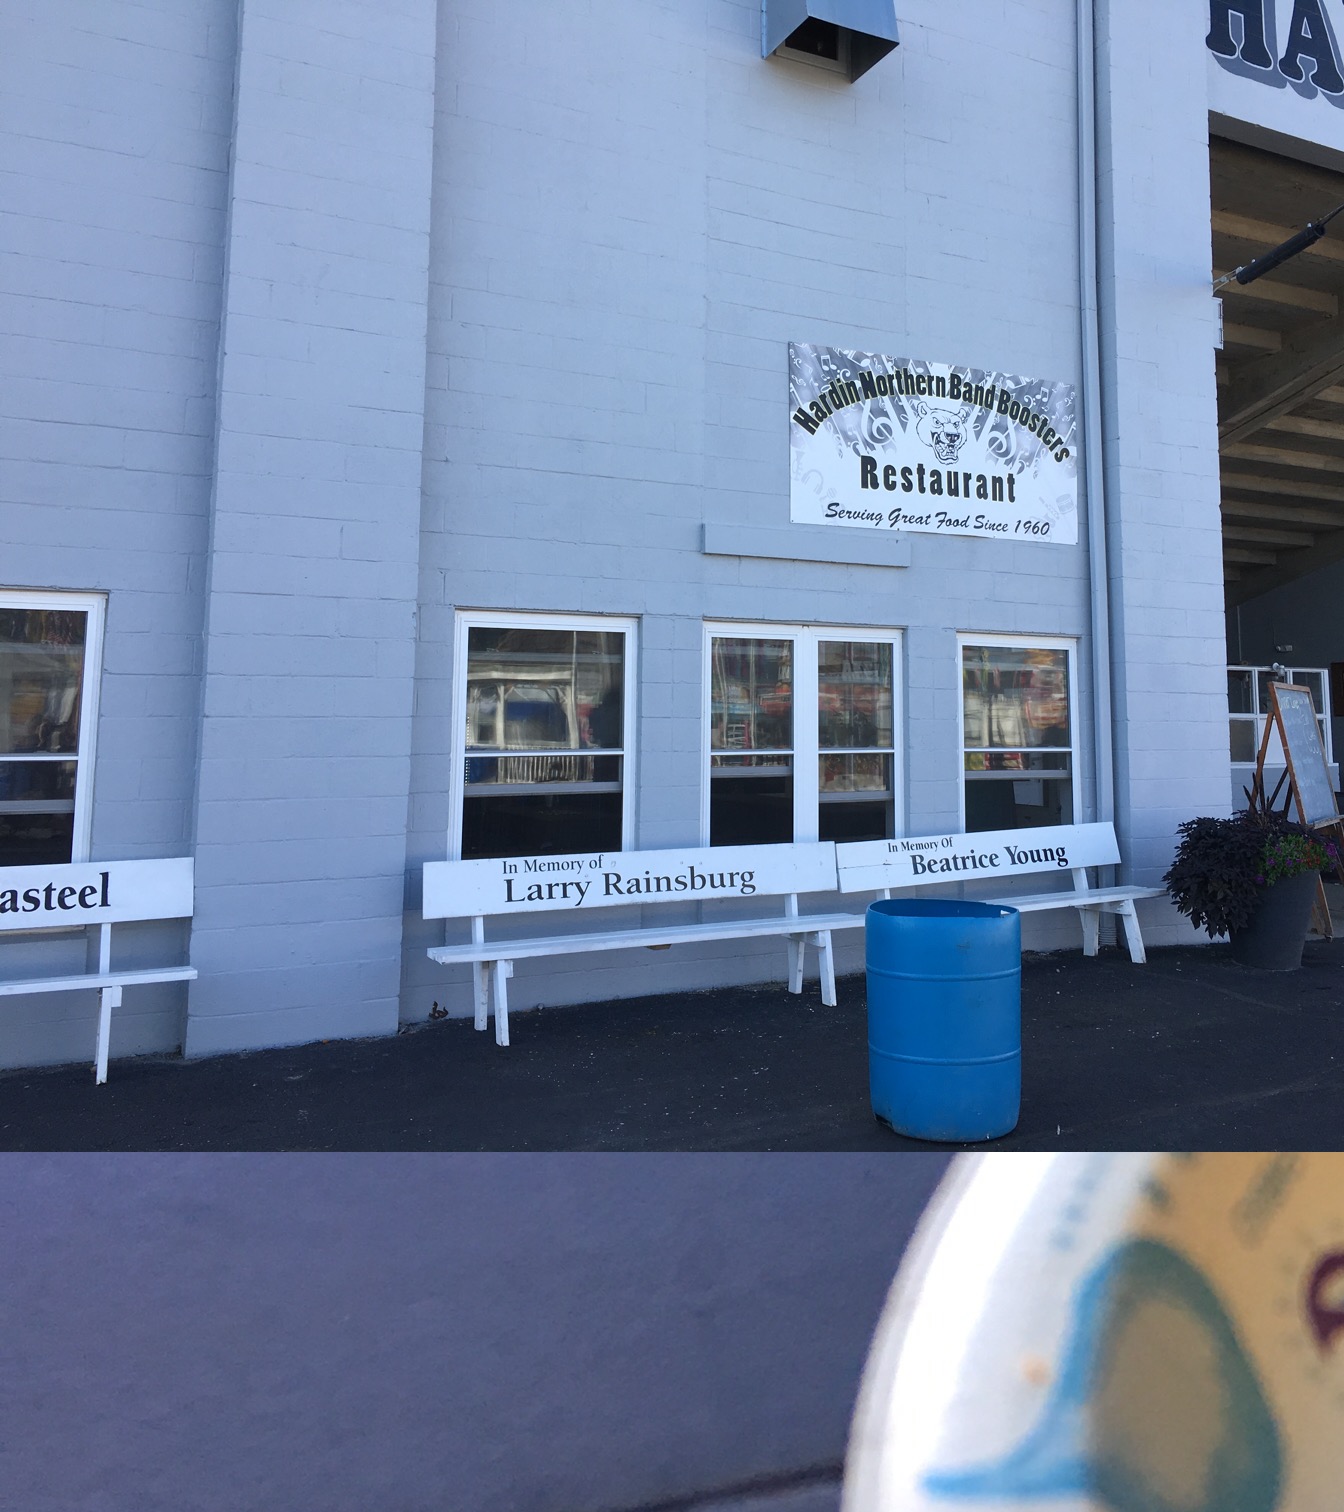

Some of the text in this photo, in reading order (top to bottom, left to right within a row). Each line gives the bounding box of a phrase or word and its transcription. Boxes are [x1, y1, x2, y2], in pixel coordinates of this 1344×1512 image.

[792, 367, 1070, 463] Hardin Northern Band Boosters
[860, 455, 1016, 503] Restaurant
[825, 502, 1050, 536] Serving Great Food Since 1960
[887, 837, 953, 852] In Memory Of
[910, 845, 1069, 875] Beatrice Young
[502, 854, 604, 875] In Memory of
[504, 865, 757, 906] Larry Rainsburg
